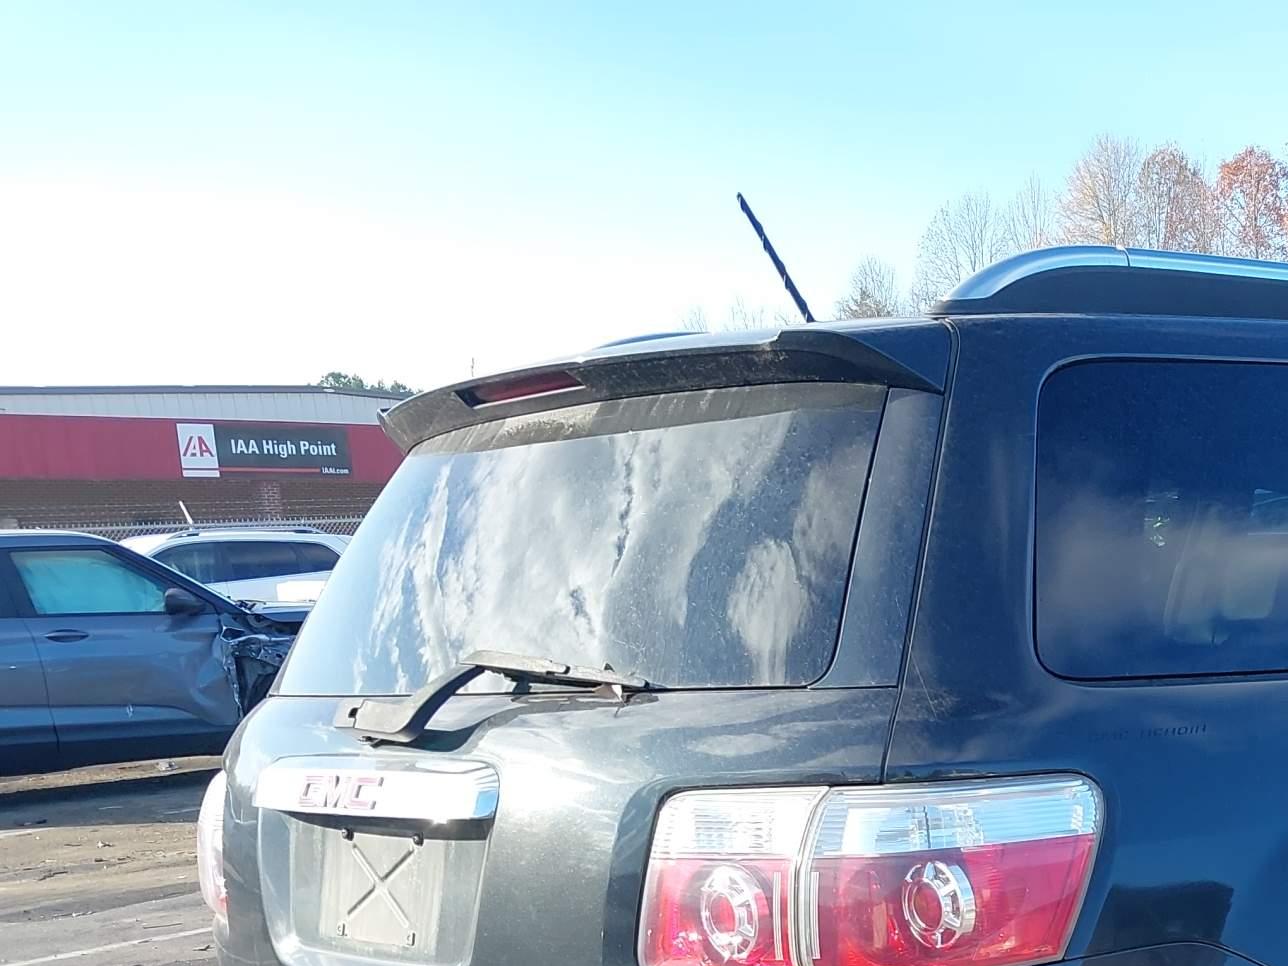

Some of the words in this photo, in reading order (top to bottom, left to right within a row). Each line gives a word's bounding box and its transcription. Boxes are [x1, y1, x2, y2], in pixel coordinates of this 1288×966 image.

[231, 439, 260, 455] IAA
[263, 439, 297, 459] High
[300, 441, 337, 456] Point
[298, 774, 385, 810] GMC
